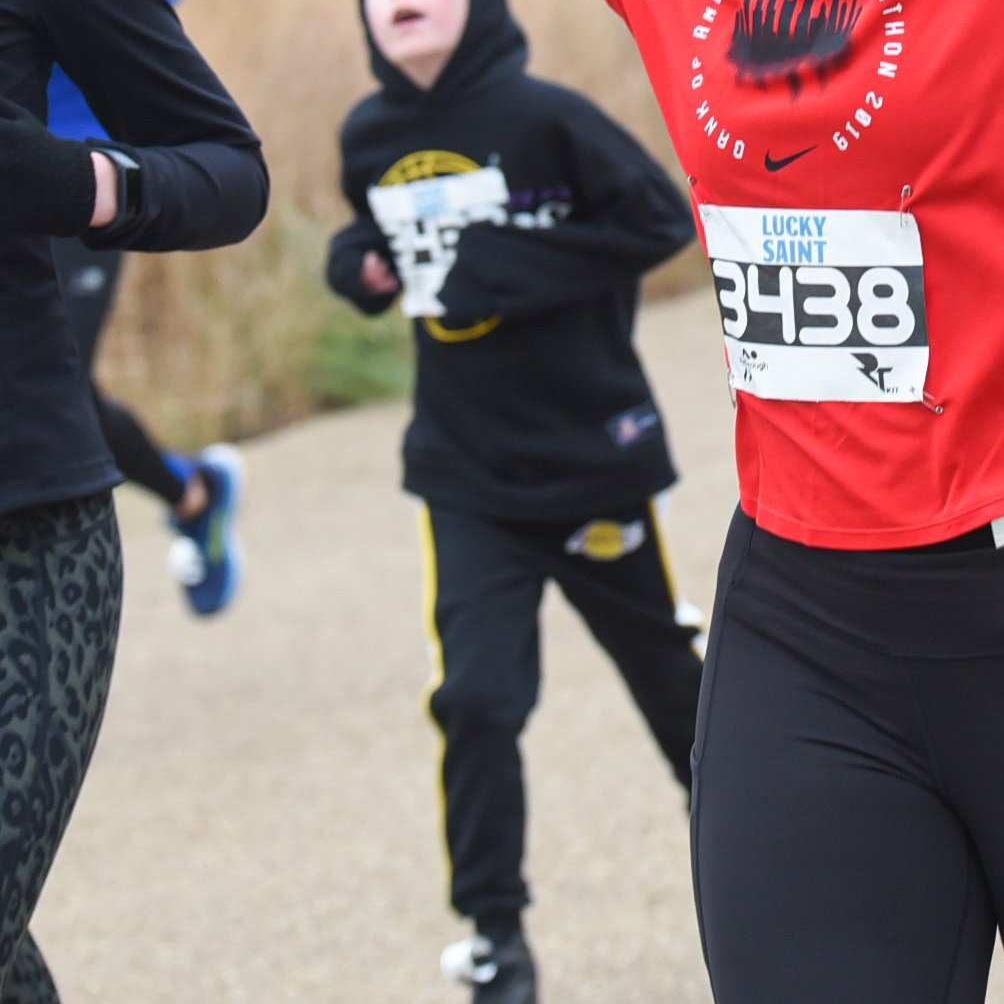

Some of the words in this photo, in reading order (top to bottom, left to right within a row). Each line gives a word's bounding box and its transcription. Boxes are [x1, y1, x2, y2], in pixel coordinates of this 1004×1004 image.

[832, 91, 884, 151] 2019
[762, 214, 827, 237] LUCKY
[762, 239, 827, 264] SAINT
[712, 259, 916, 346] 3438
